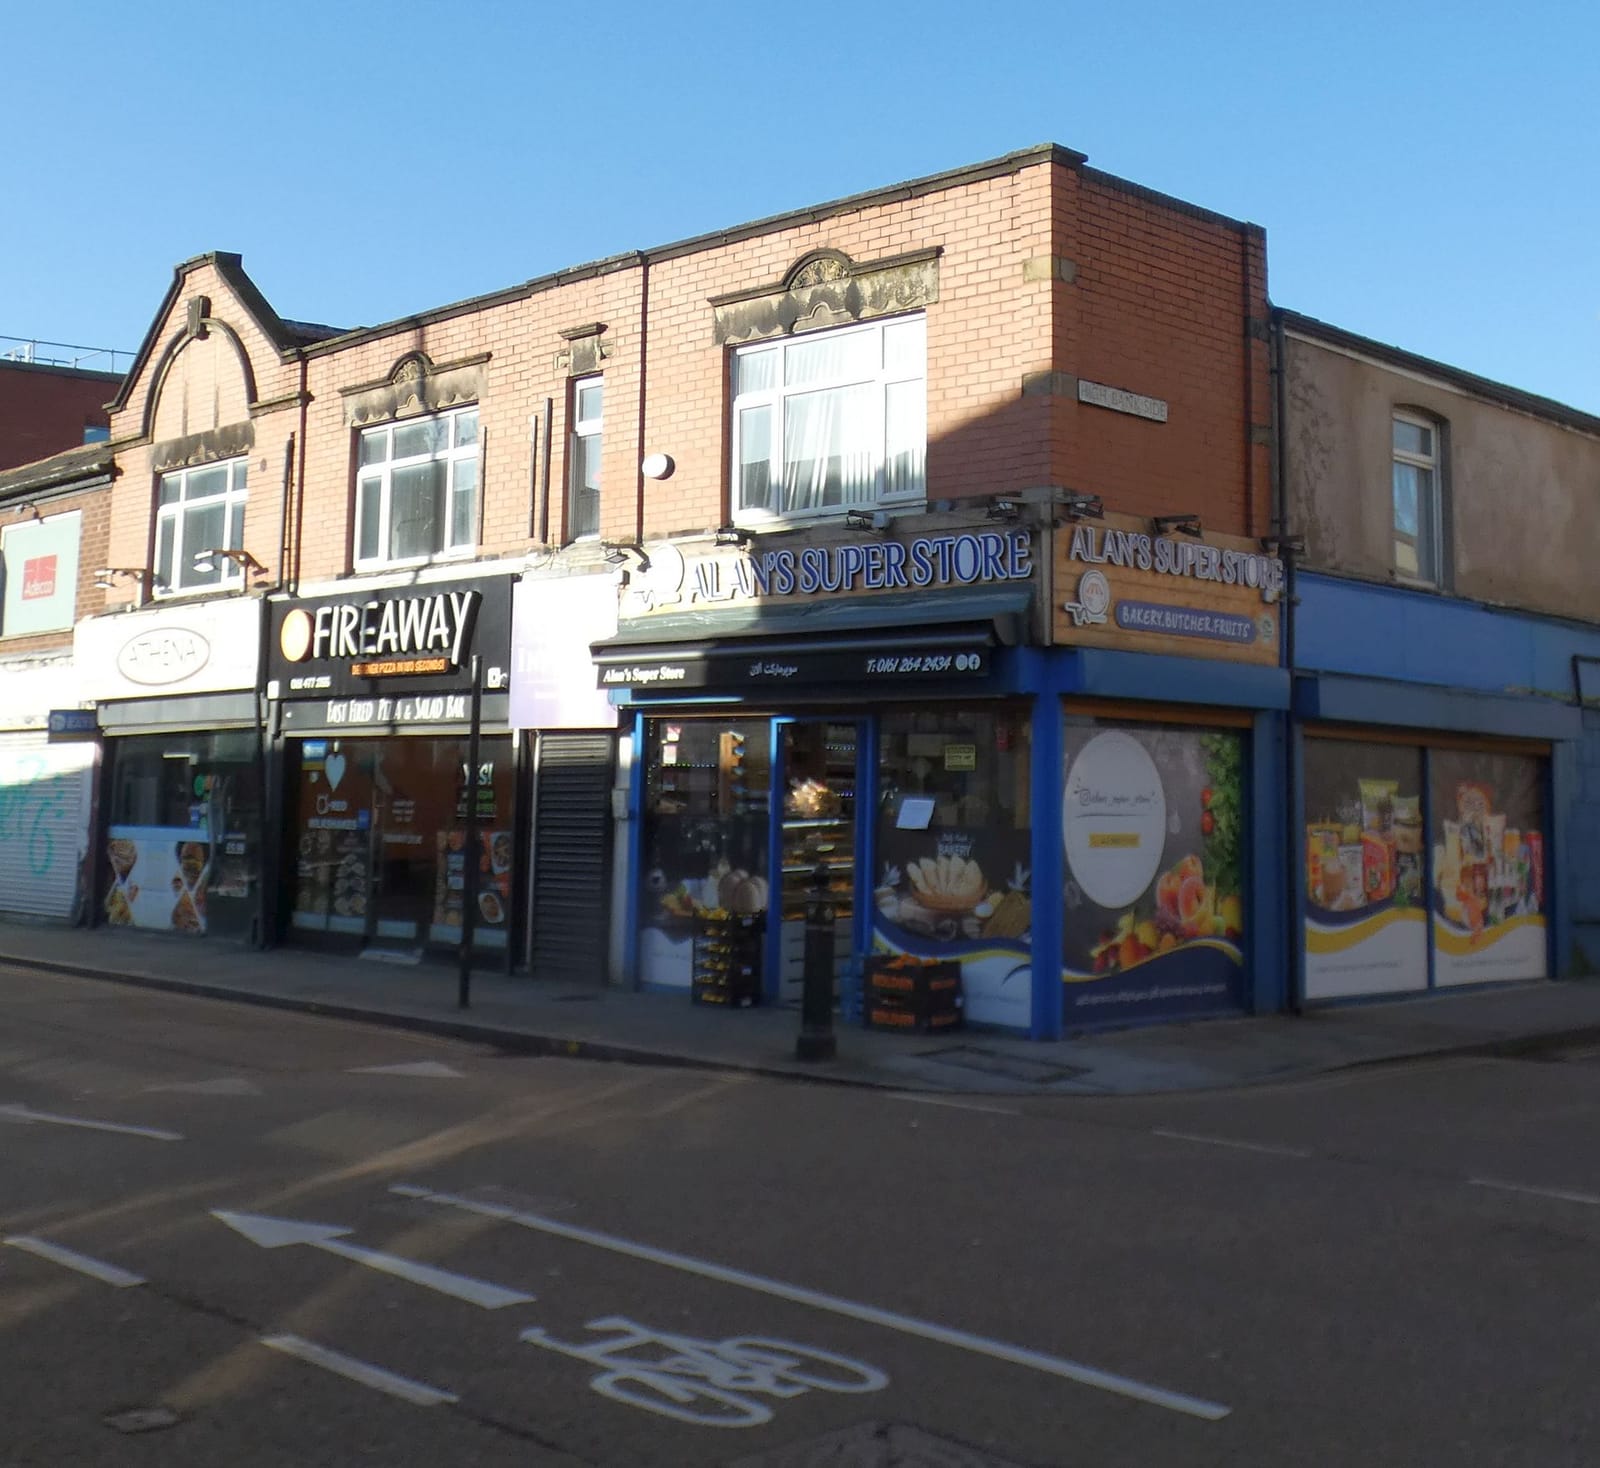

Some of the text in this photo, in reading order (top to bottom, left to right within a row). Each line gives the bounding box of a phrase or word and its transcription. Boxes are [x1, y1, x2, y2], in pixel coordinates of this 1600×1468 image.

[691, 531, 1033, 602] ALAN'S SUPER STORE
[1070, 525, 1284, 591] ALAN'S SUPER STORE
[313, 591, 474, 664] FIREAWAY
[604, 666, 685, 684] Alan's Super Store
[899, 657, 922, 672] 264
[414, 696, 443, 720] SALAD
[445, 694, 465, 718] BAR
[462, 762, 493, 785] YS!
[937, 841, 973, 856] BAKERY
